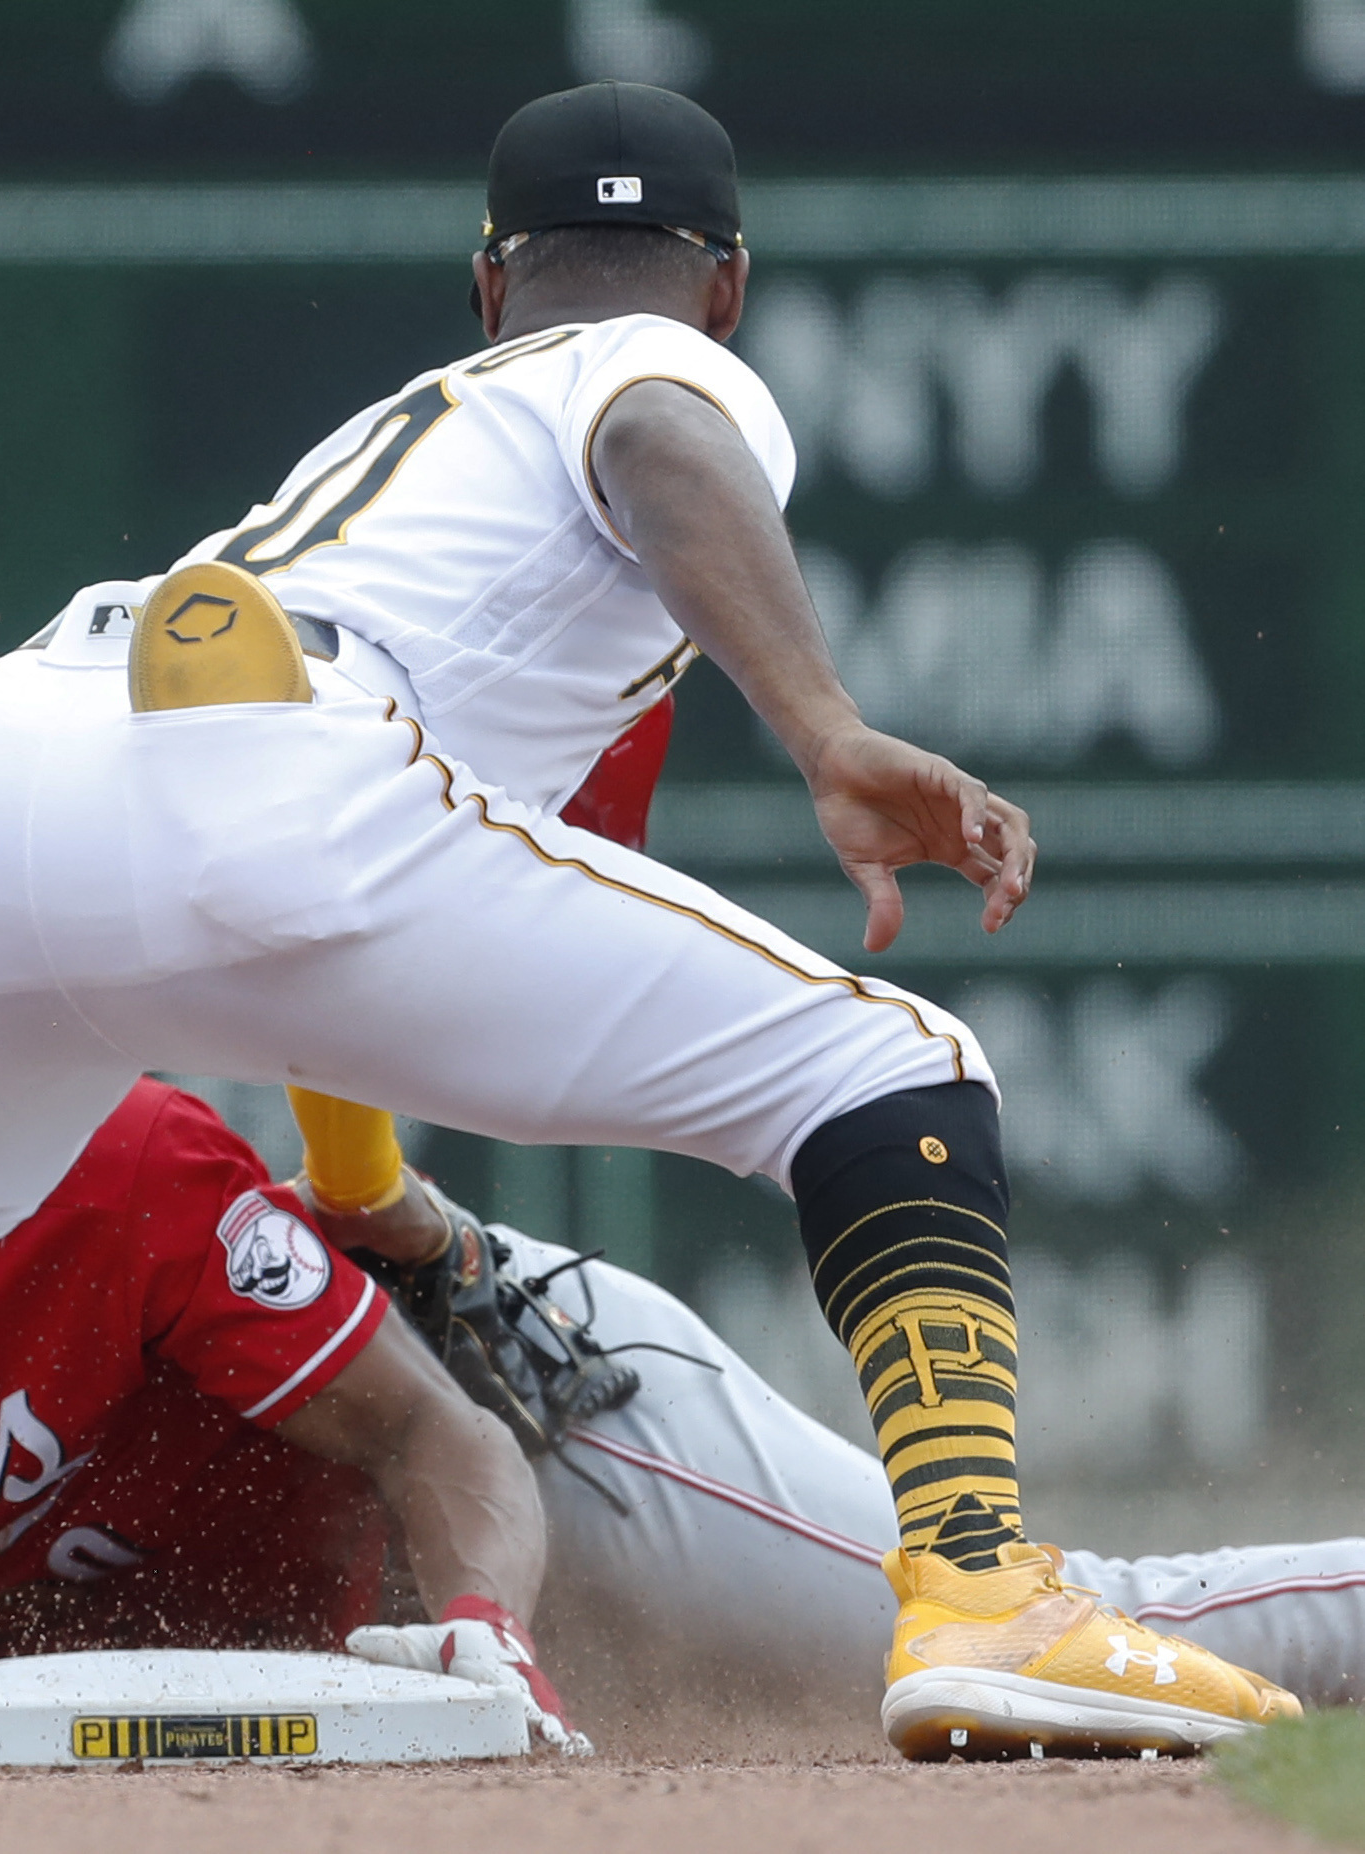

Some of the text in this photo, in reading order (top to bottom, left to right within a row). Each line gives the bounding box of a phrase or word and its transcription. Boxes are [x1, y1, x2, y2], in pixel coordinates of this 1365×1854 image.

[892, 1304, 986, 1408] P
[81, 1722, 103, 1754] P
[287, 1719, 309, 1752] P
